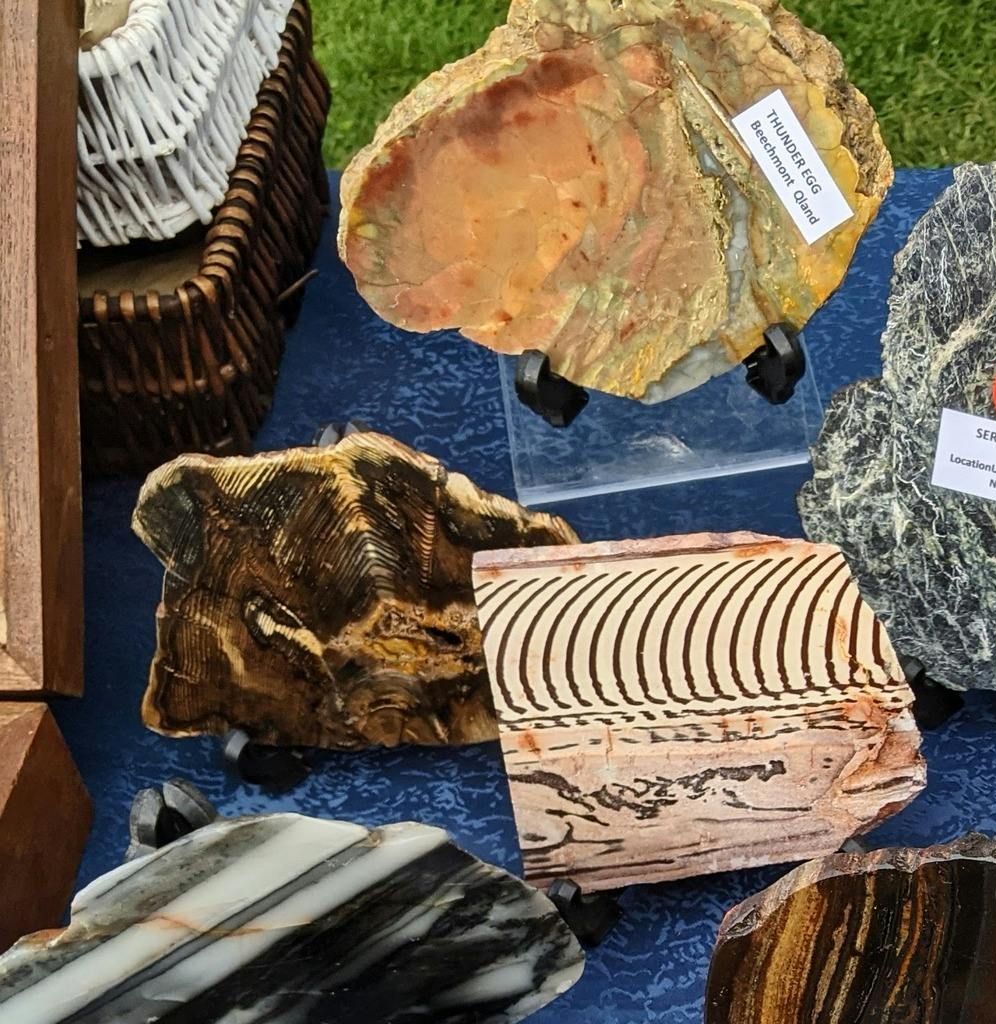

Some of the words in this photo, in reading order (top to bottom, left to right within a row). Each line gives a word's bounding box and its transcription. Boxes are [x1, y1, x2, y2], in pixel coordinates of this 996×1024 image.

[750, 119, 795, 188] Beechmont
[793, 189, 820, 225] Qland
[766, 108, 807, 169] THUNDER
[801, 168, 822, 195] EGG
